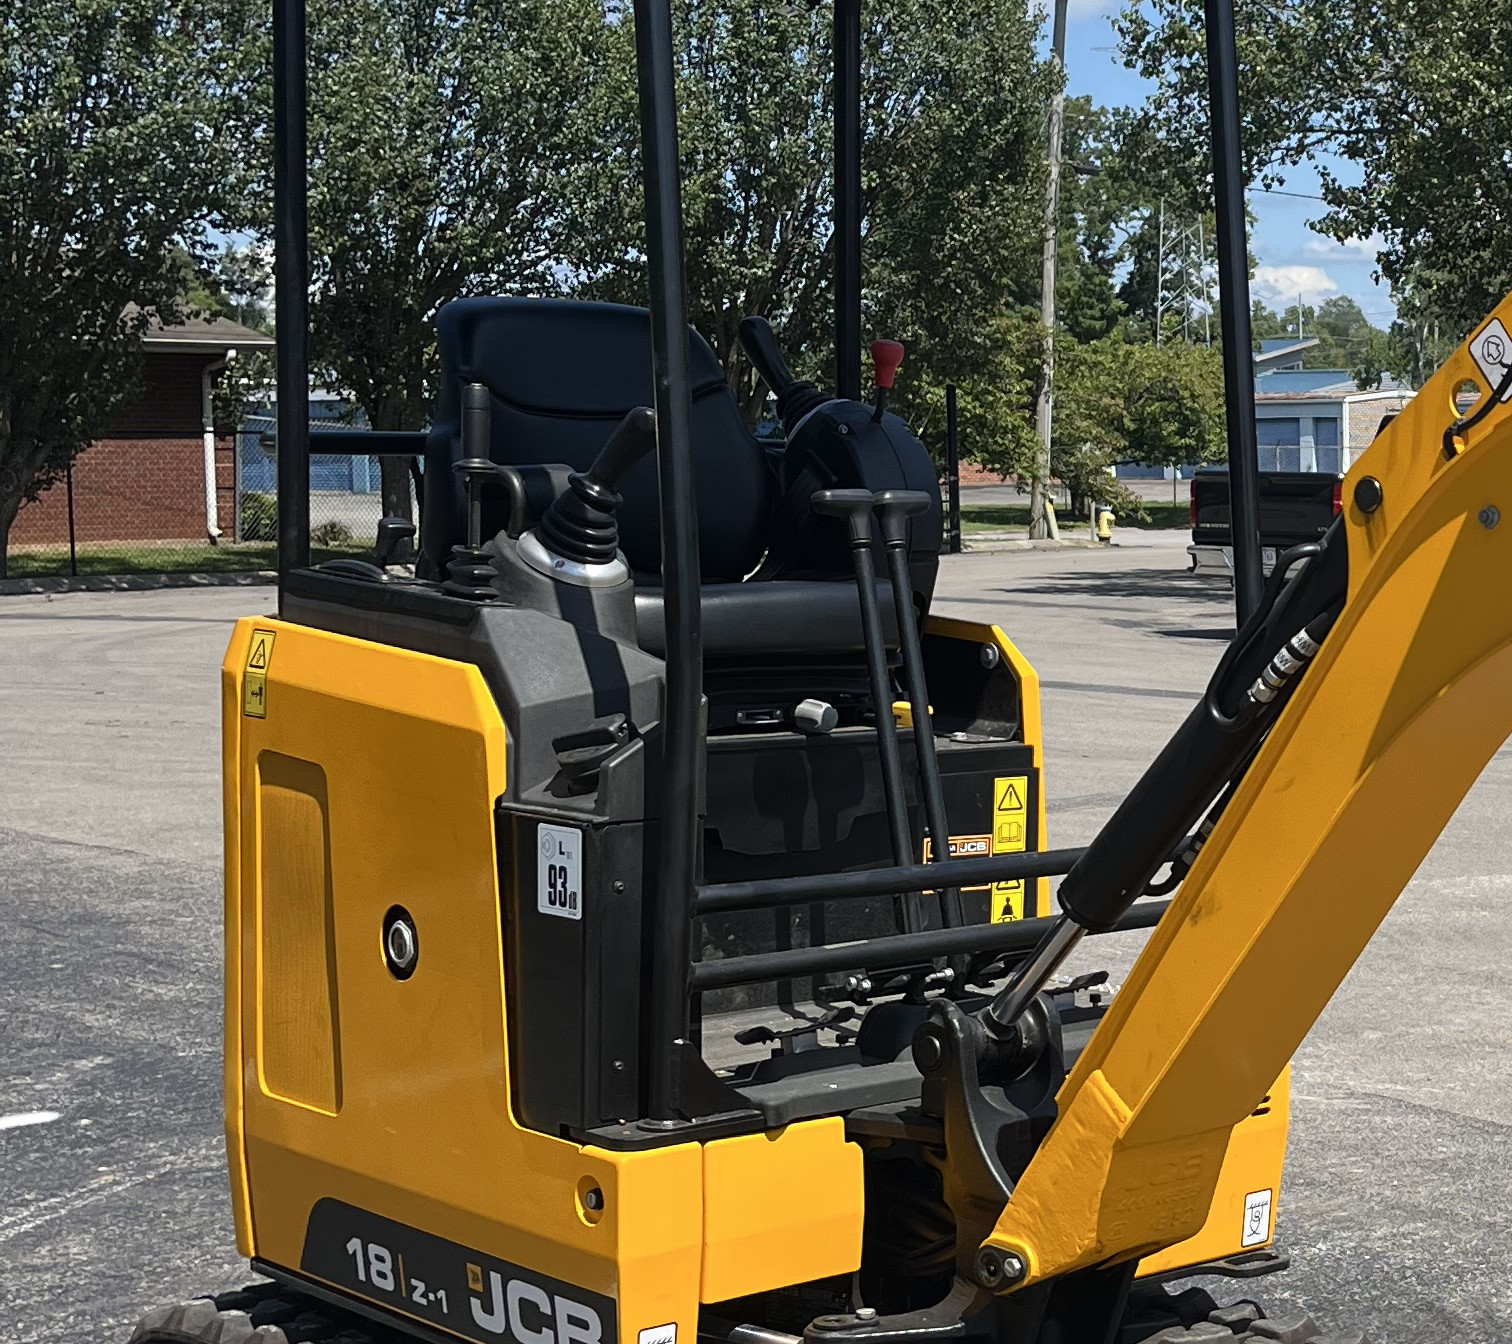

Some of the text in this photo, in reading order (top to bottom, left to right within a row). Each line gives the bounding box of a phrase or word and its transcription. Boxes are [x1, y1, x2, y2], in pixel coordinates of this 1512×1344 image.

[559, 840, 566, 856] L
[960, 842, 987, 853] JCB
[548, 863, 568, 908] 93
[346, 1237, 395, 1292] 18
